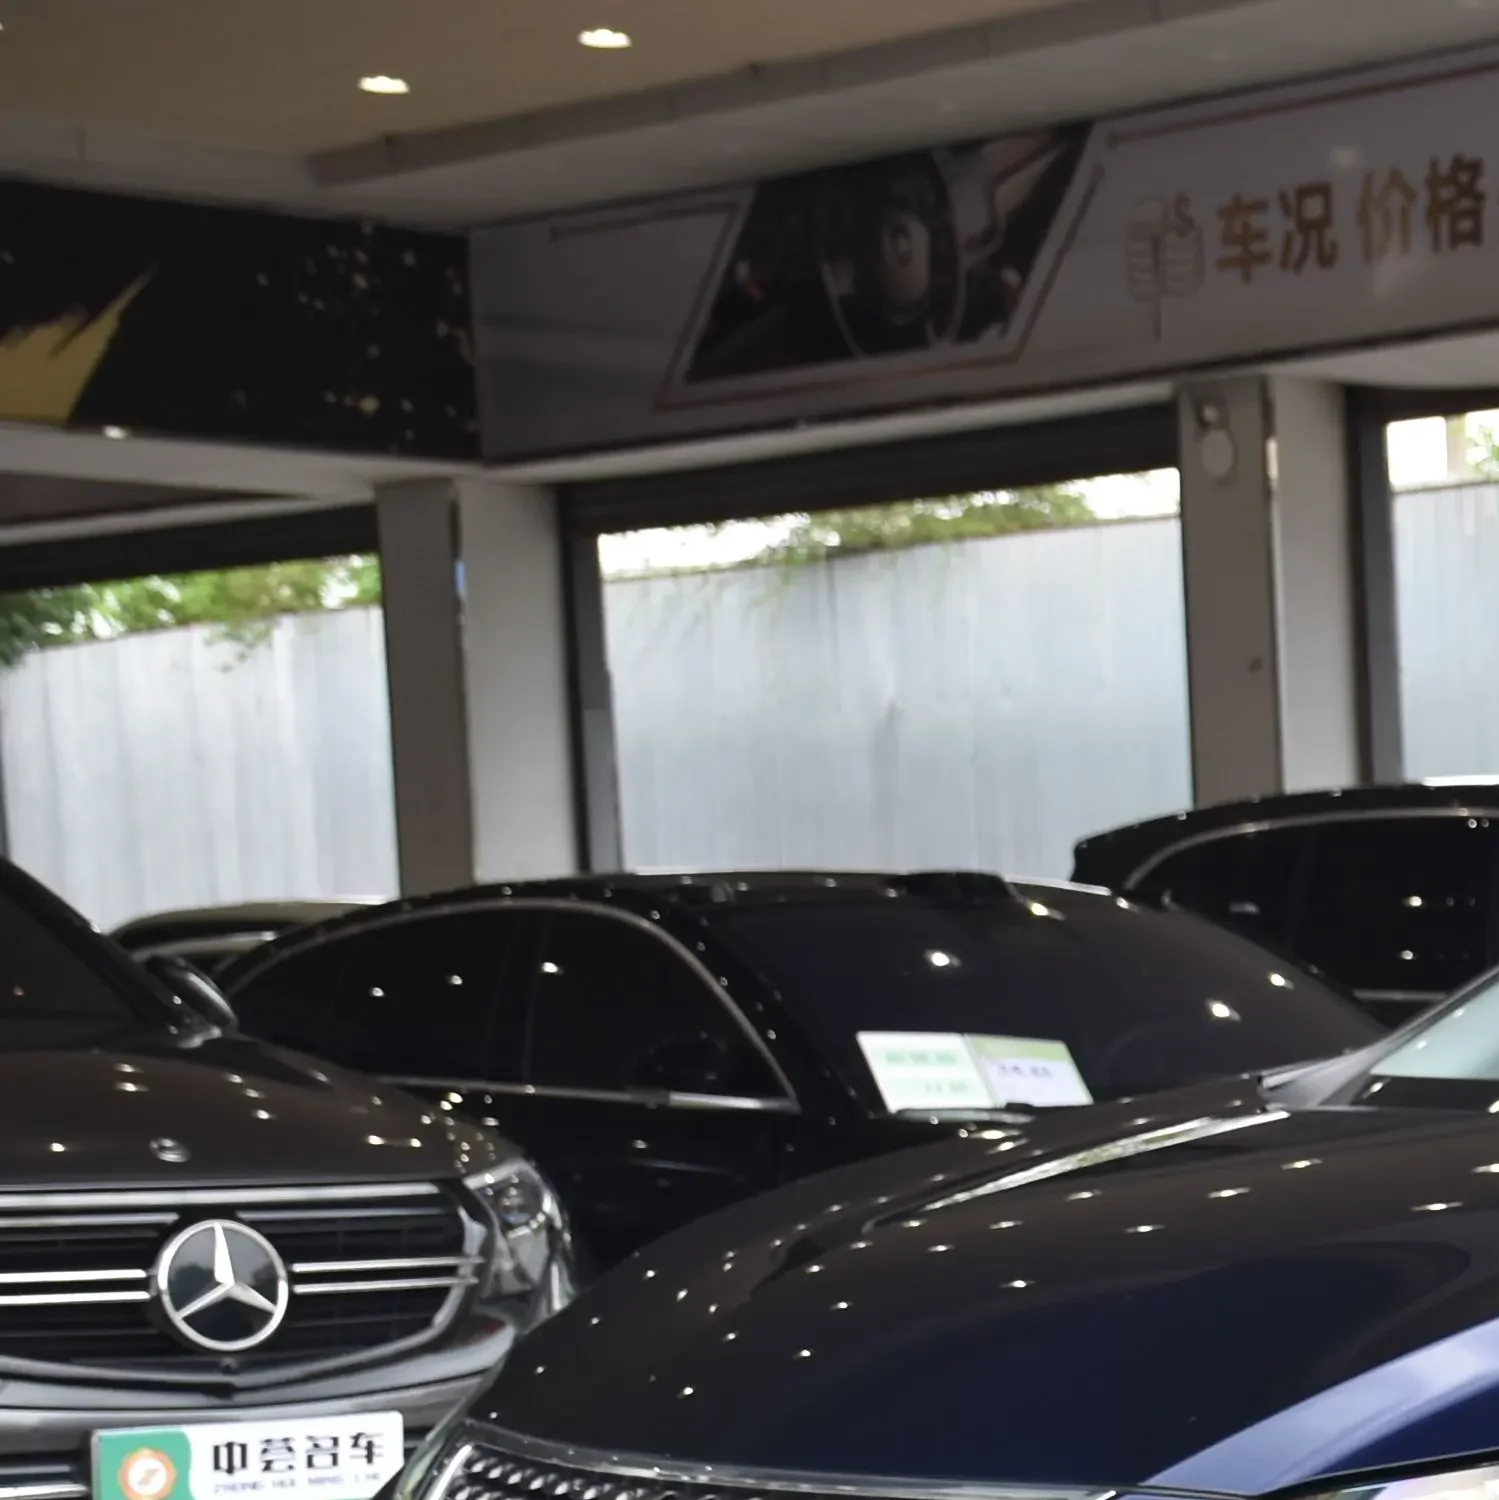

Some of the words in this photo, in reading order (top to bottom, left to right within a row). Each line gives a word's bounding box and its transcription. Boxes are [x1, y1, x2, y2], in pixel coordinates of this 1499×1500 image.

[1215, 180, 1338, 284] 车况
[1356, 153, 1486, 266] 价格
[213, 1432, 385, 1475] 中荟名车
